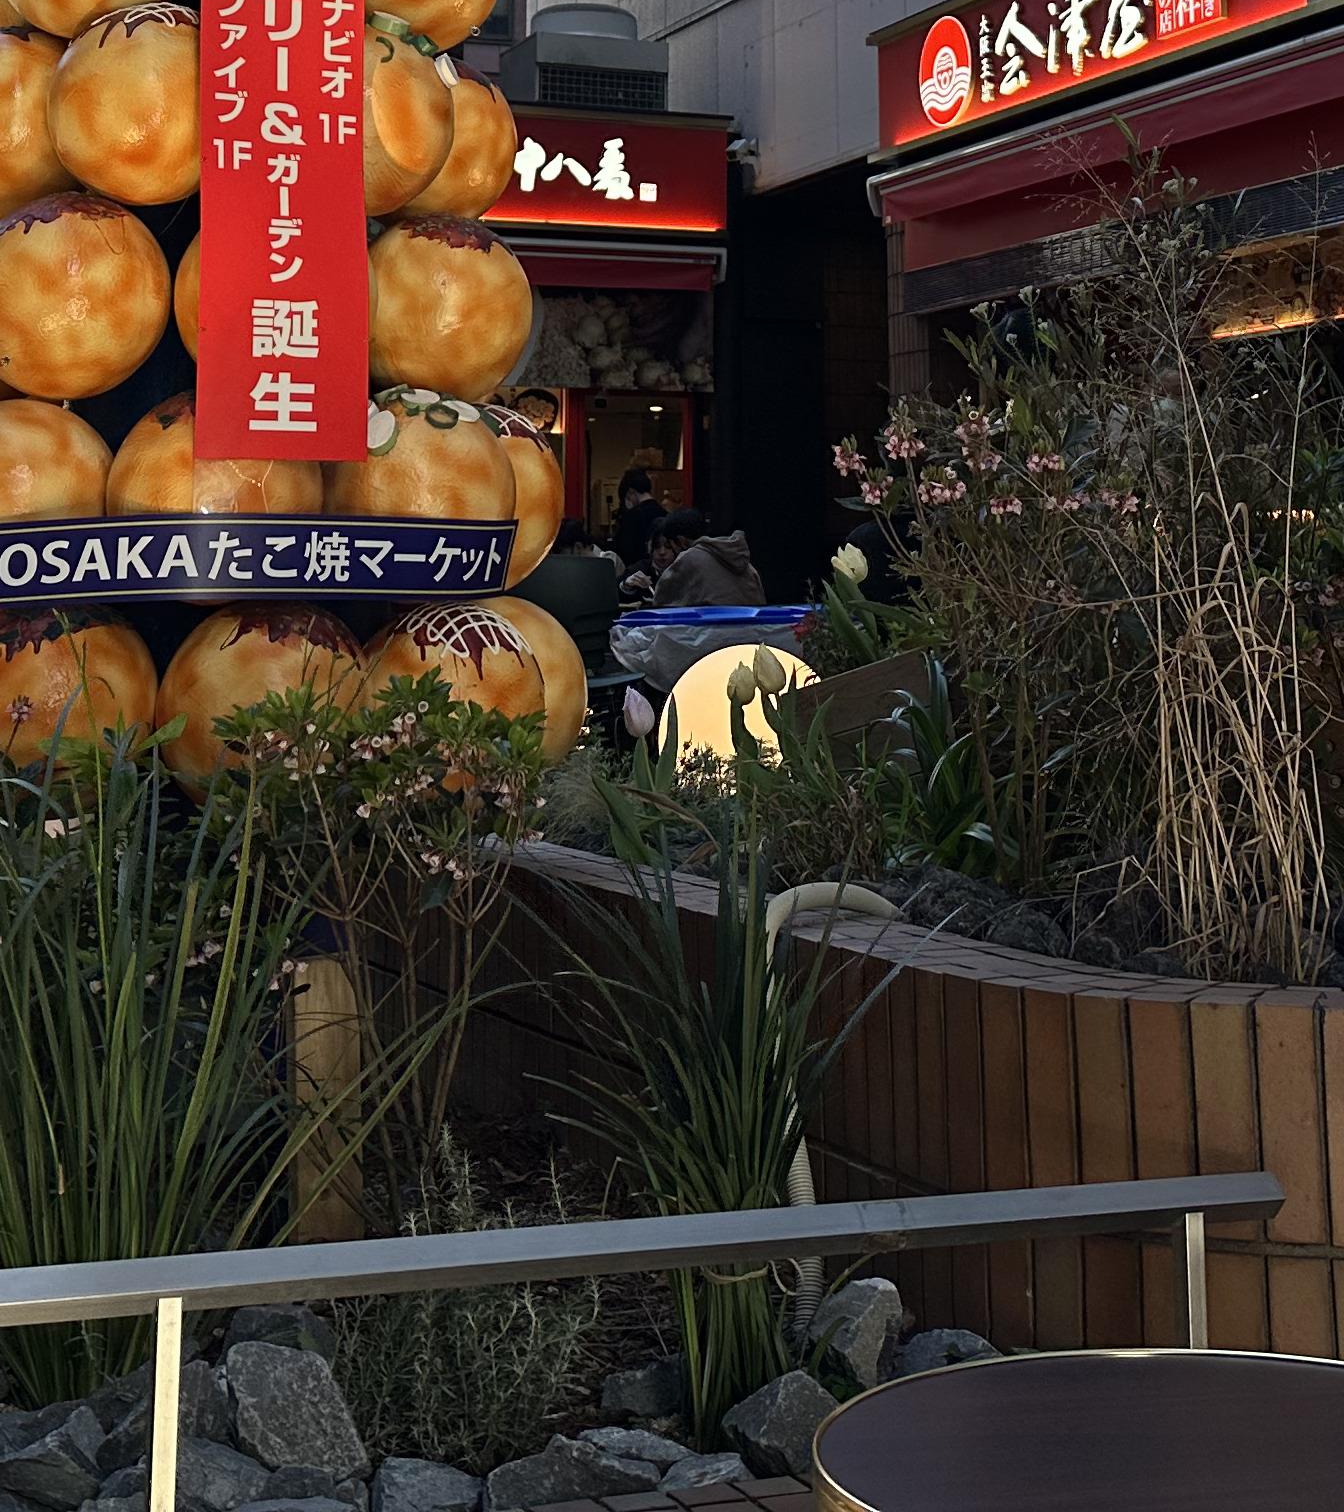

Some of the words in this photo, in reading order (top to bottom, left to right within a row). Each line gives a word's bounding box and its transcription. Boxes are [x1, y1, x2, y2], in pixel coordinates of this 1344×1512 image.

[318, 112, 358, 146] 1F
[211, 137, 254, 171] 1F
[248, 298, 320, 433] 誕生
